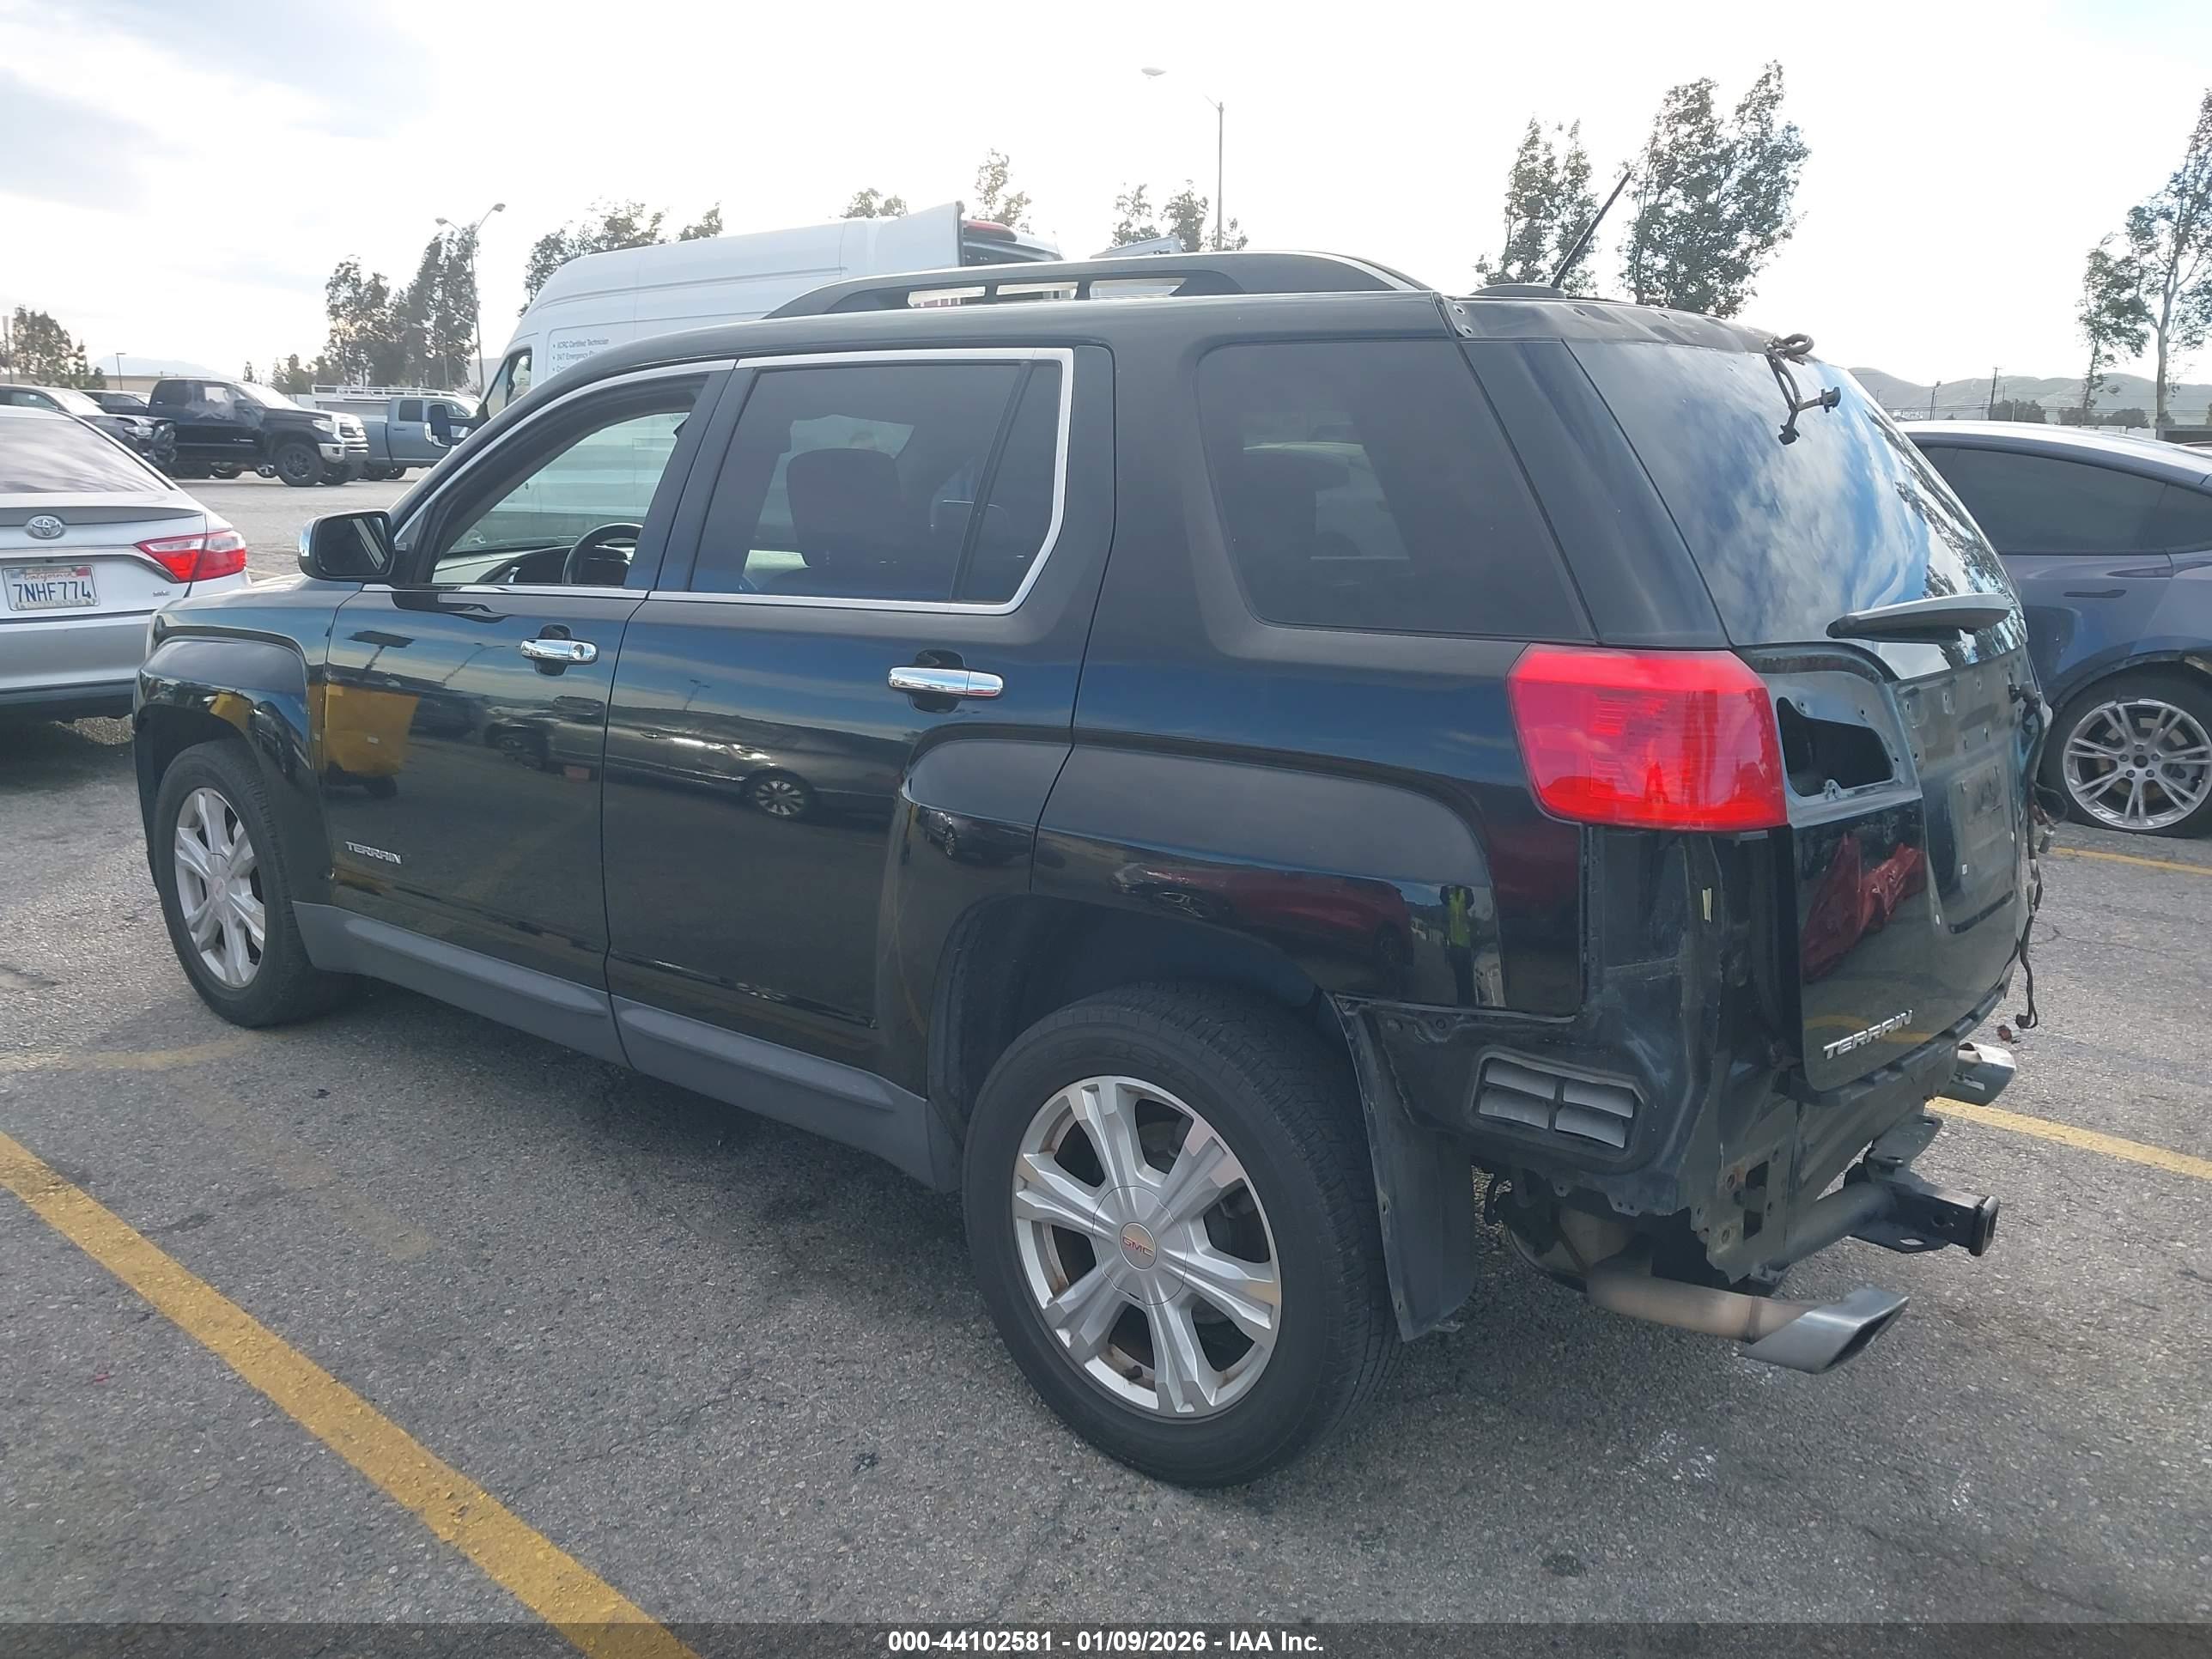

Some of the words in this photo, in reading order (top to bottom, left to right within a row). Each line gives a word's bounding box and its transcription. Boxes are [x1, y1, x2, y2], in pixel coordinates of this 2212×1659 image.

[12, 580, 92, 603] 7NHF774
[345, 841, 402, 865] TERRAIN
[1823, 1009, 1913, 1060] TERRAIN
[1121, 1236, 1154, 1257] GMC
